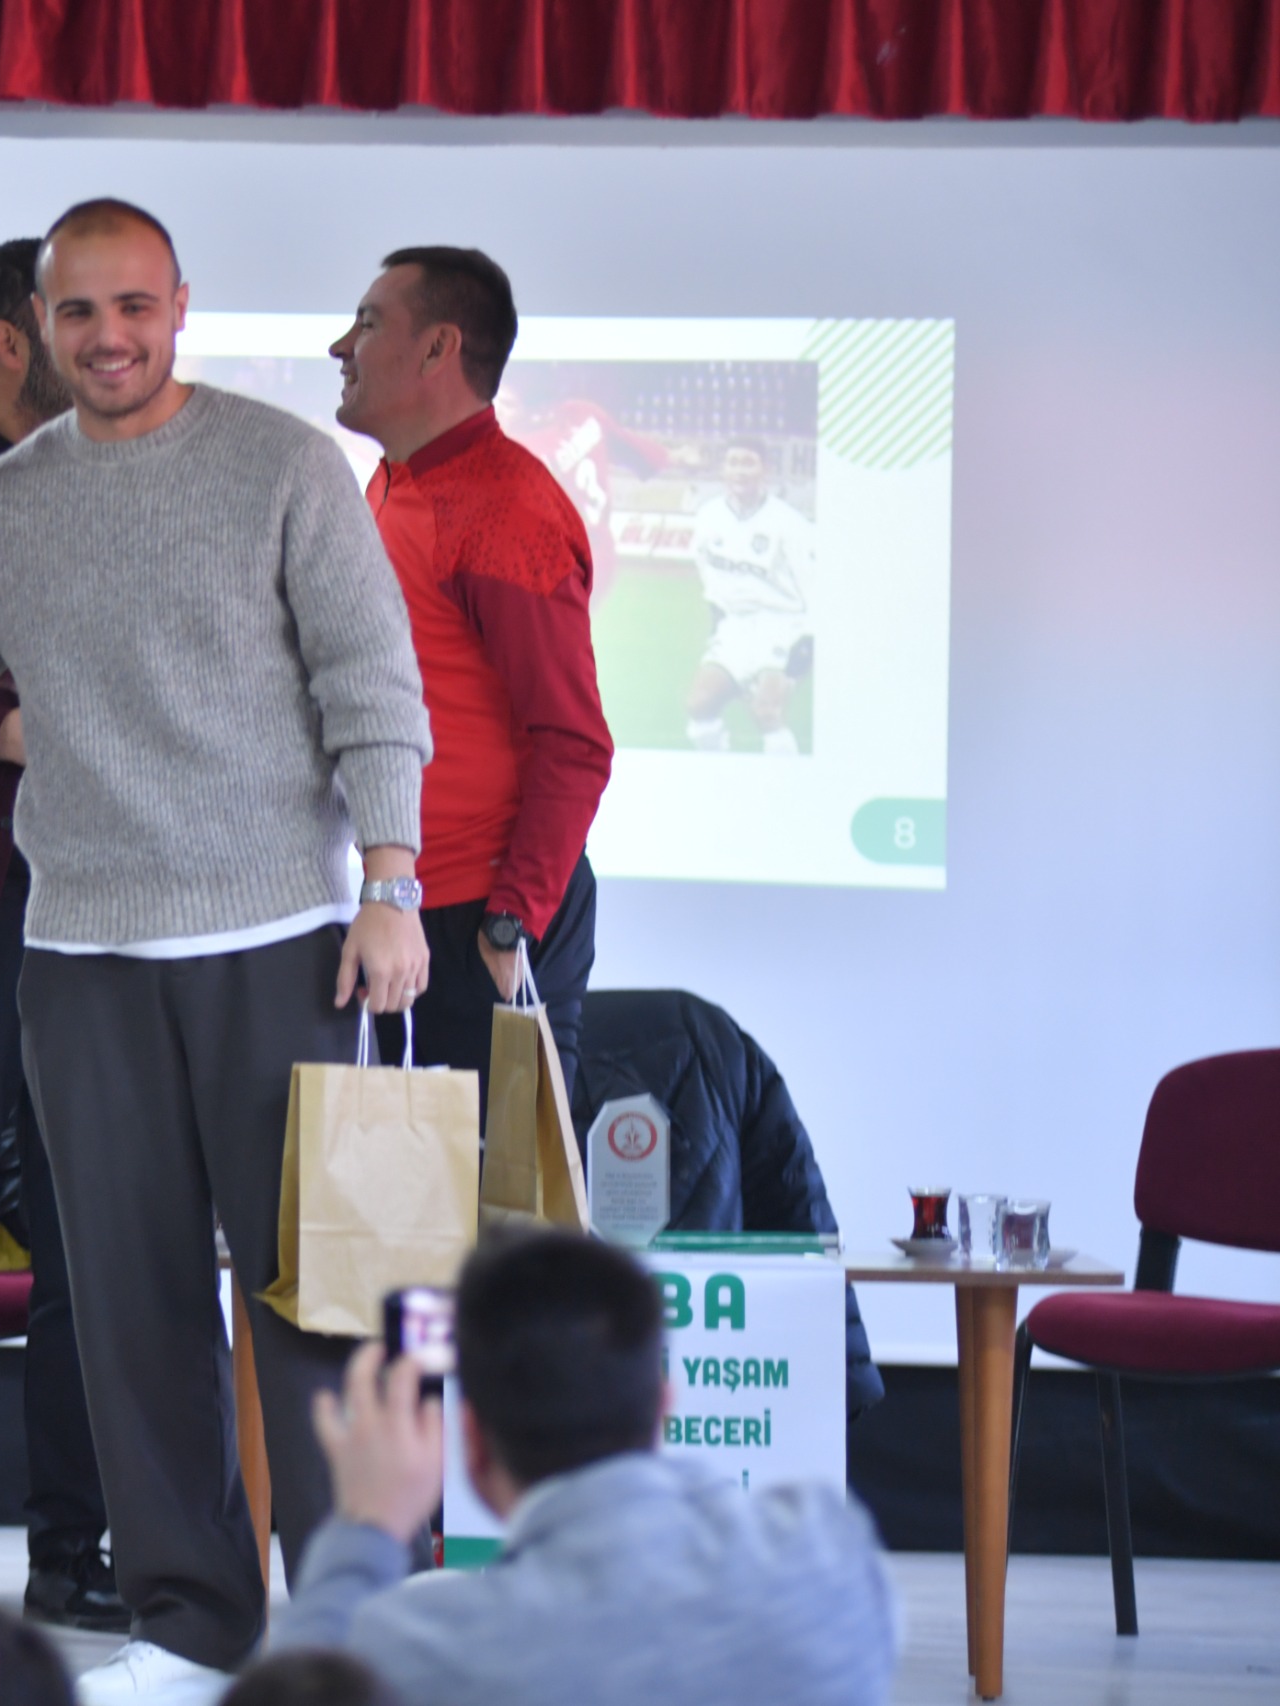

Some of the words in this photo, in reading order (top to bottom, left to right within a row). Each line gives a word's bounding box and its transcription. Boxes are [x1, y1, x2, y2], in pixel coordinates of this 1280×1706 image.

[894, 816, 917, 850] 8
[682, 1356, 789, 1394] YAŞAM
[663, 1408, 772, 1447] BECERİ
